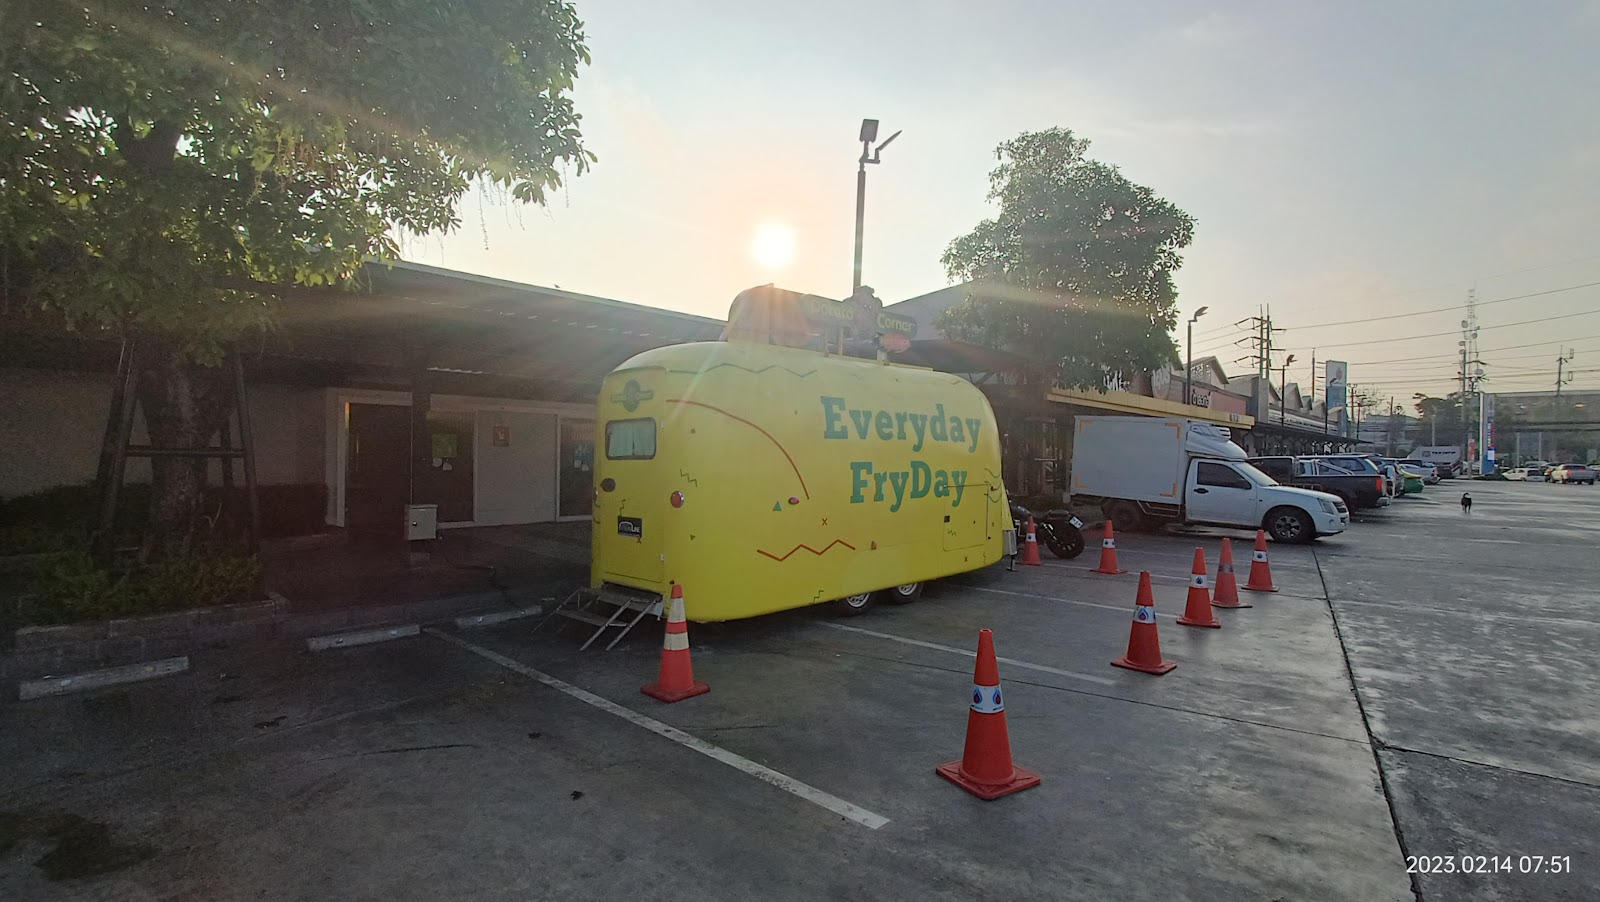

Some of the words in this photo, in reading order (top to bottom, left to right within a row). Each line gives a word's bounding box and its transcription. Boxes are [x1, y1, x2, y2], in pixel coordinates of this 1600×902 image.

[877, 313, 913, 333] Corner
[820, 395, 981, 453] Everyday
[850, 460, 968, 513] FryDay
